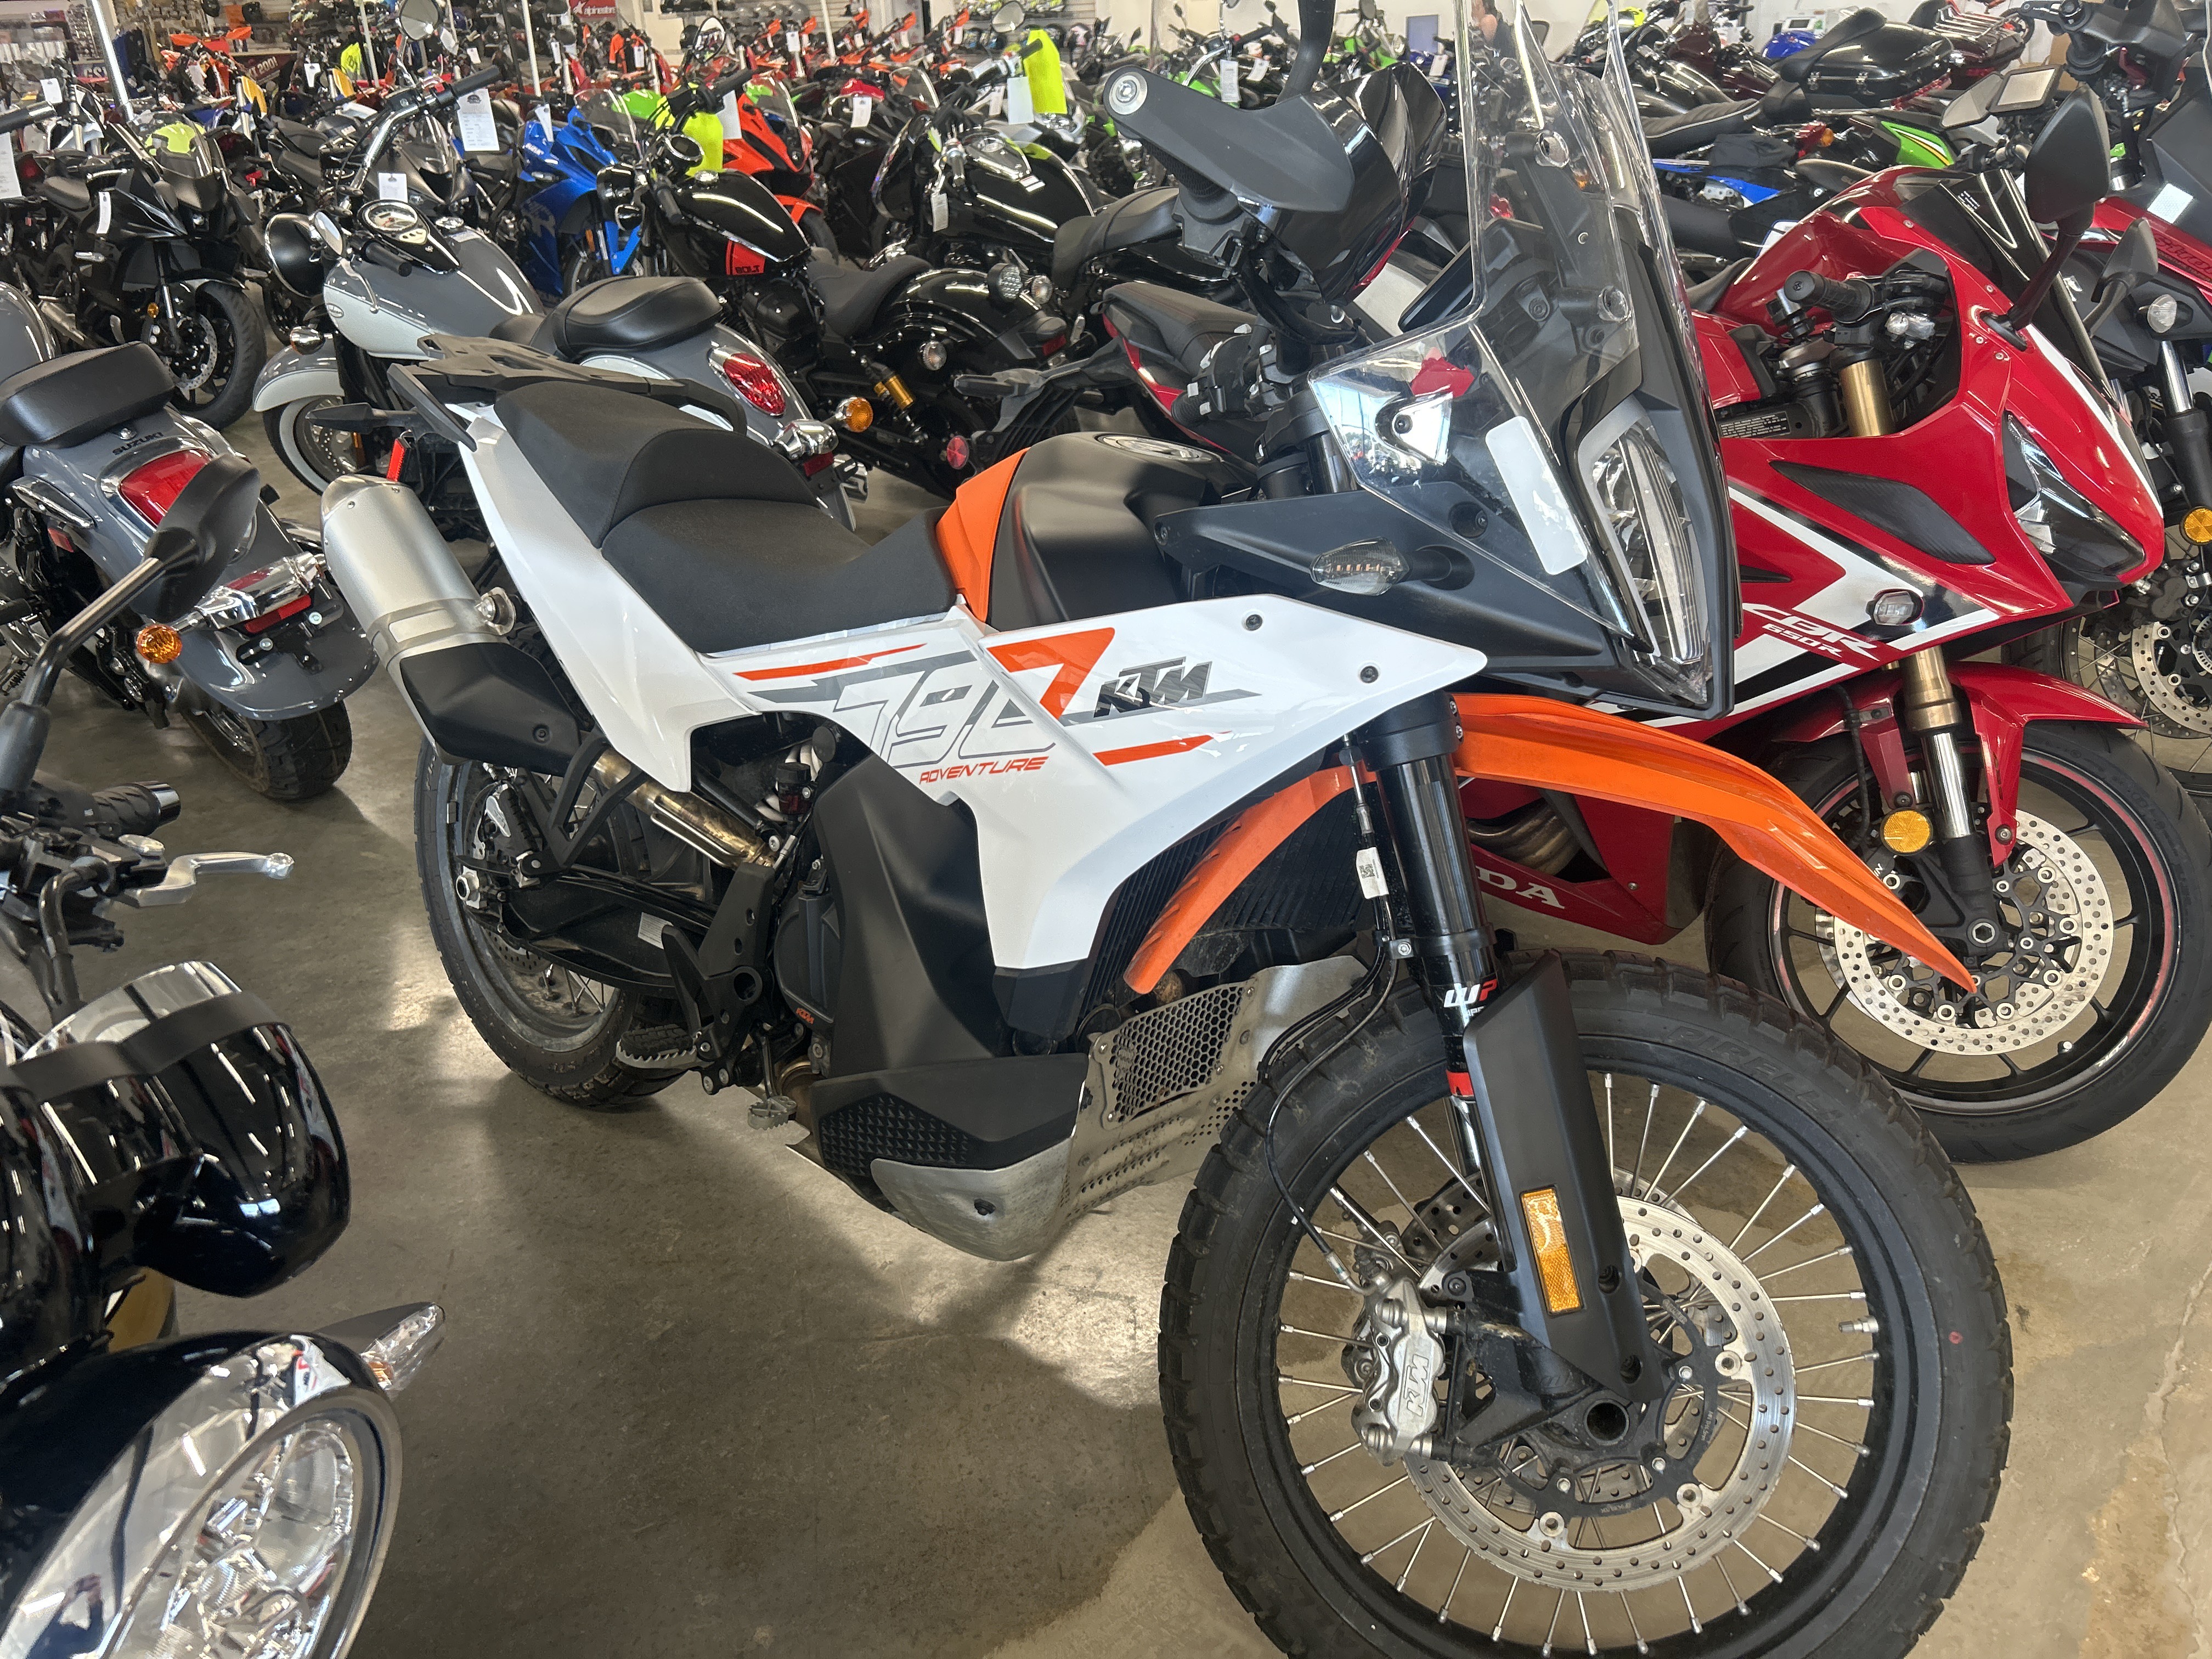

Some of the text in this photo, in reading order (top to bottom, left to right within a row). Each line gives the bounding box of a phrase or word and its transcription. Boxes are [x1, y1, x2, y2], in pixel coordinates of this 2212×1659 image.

[735, 265, 760, 274] BOLT
[112, 432, 164, 455] SUZUKI
[1742, 602, 1880, 662] CBR
[1762, 623, 1842, 658] 650R
[1093, 656, 1212, 718] KTM
[919, 756, 1049, 785] ADVENTURE
[795, 1007, 815, 1024] KTM
[1668, 1025, 1844, 1120] PIRELLI
[1403, 1353, 1429, 1417] KTM
